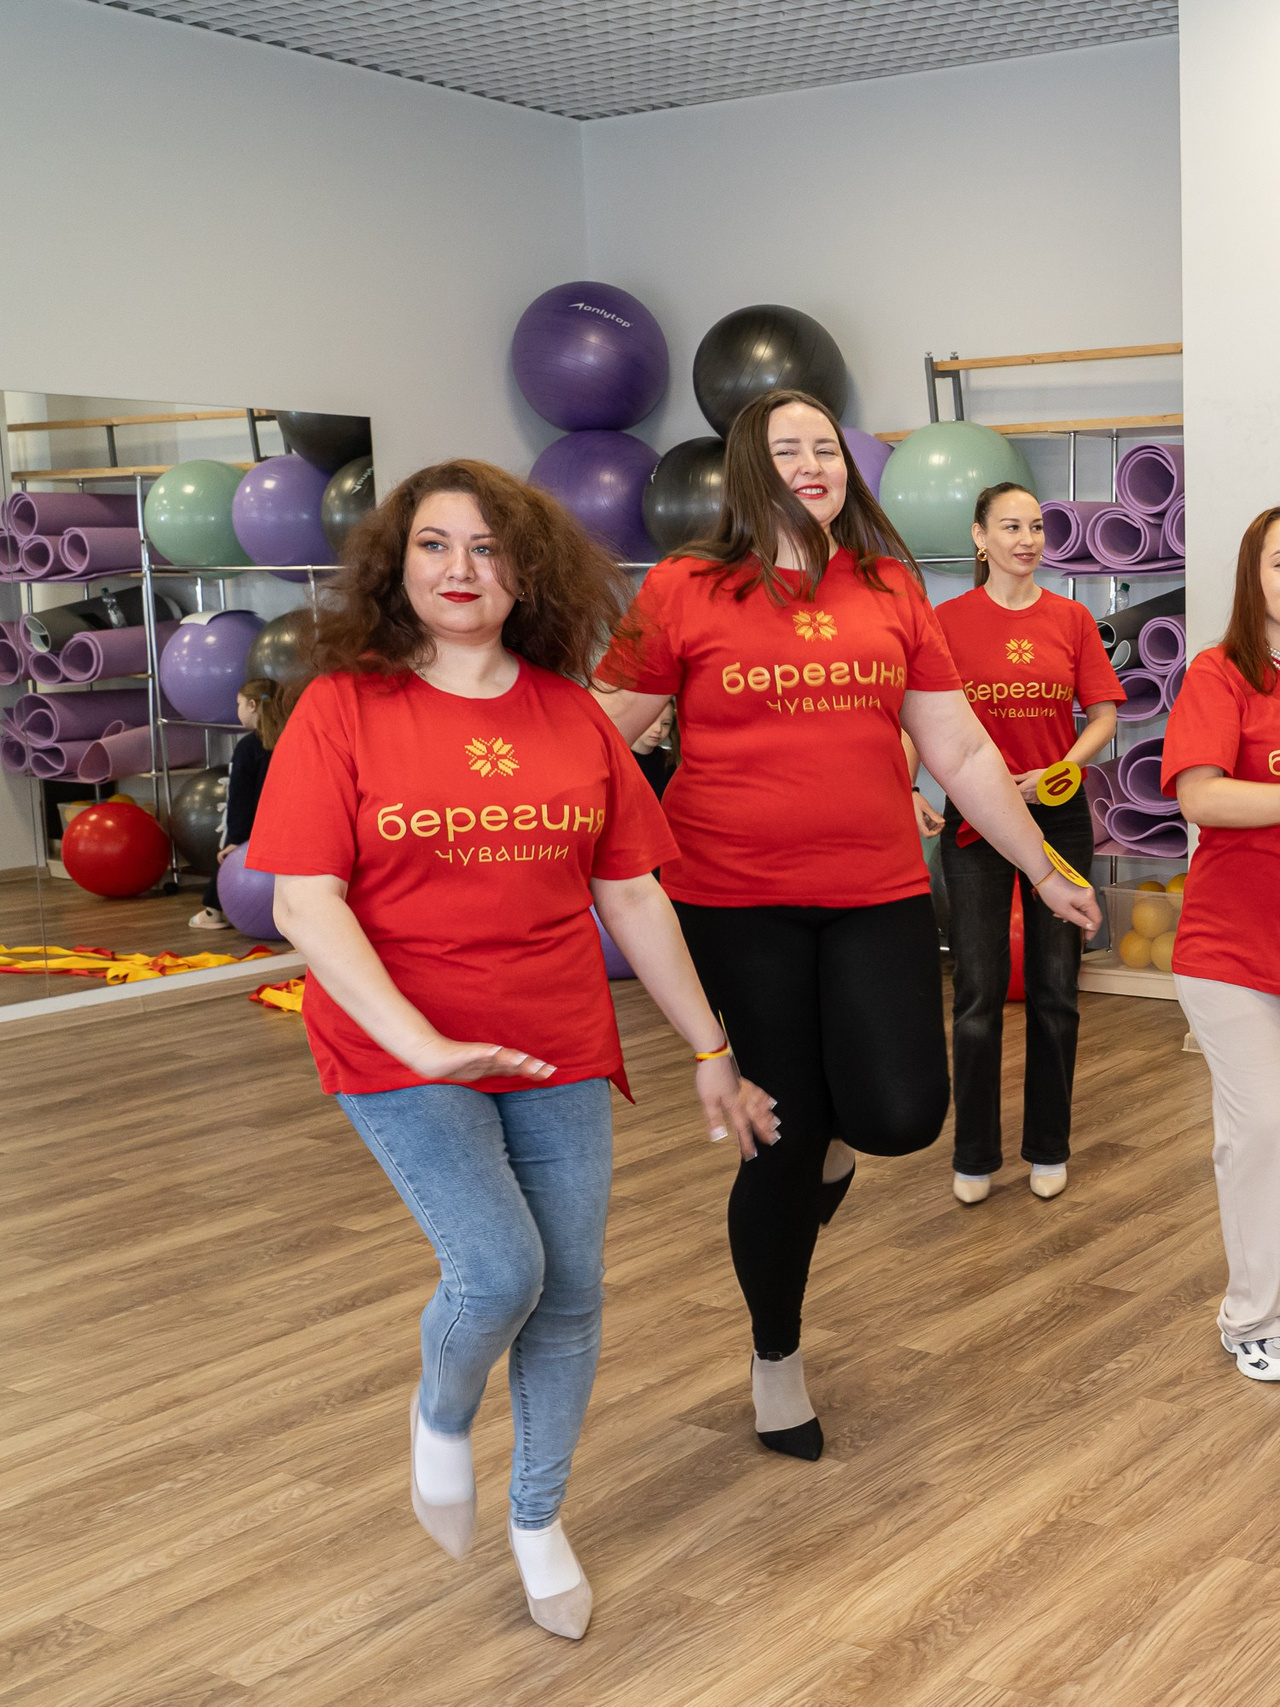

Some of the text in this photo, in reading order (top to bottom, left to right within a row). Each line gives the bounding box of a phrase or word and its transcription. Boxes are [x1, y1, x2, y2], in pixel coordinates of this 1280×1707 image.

[766, 695, 881, 716] чувашии
[988, 707, 1057, 718] чувашии
[435, 845, 569, 866] чувашии
